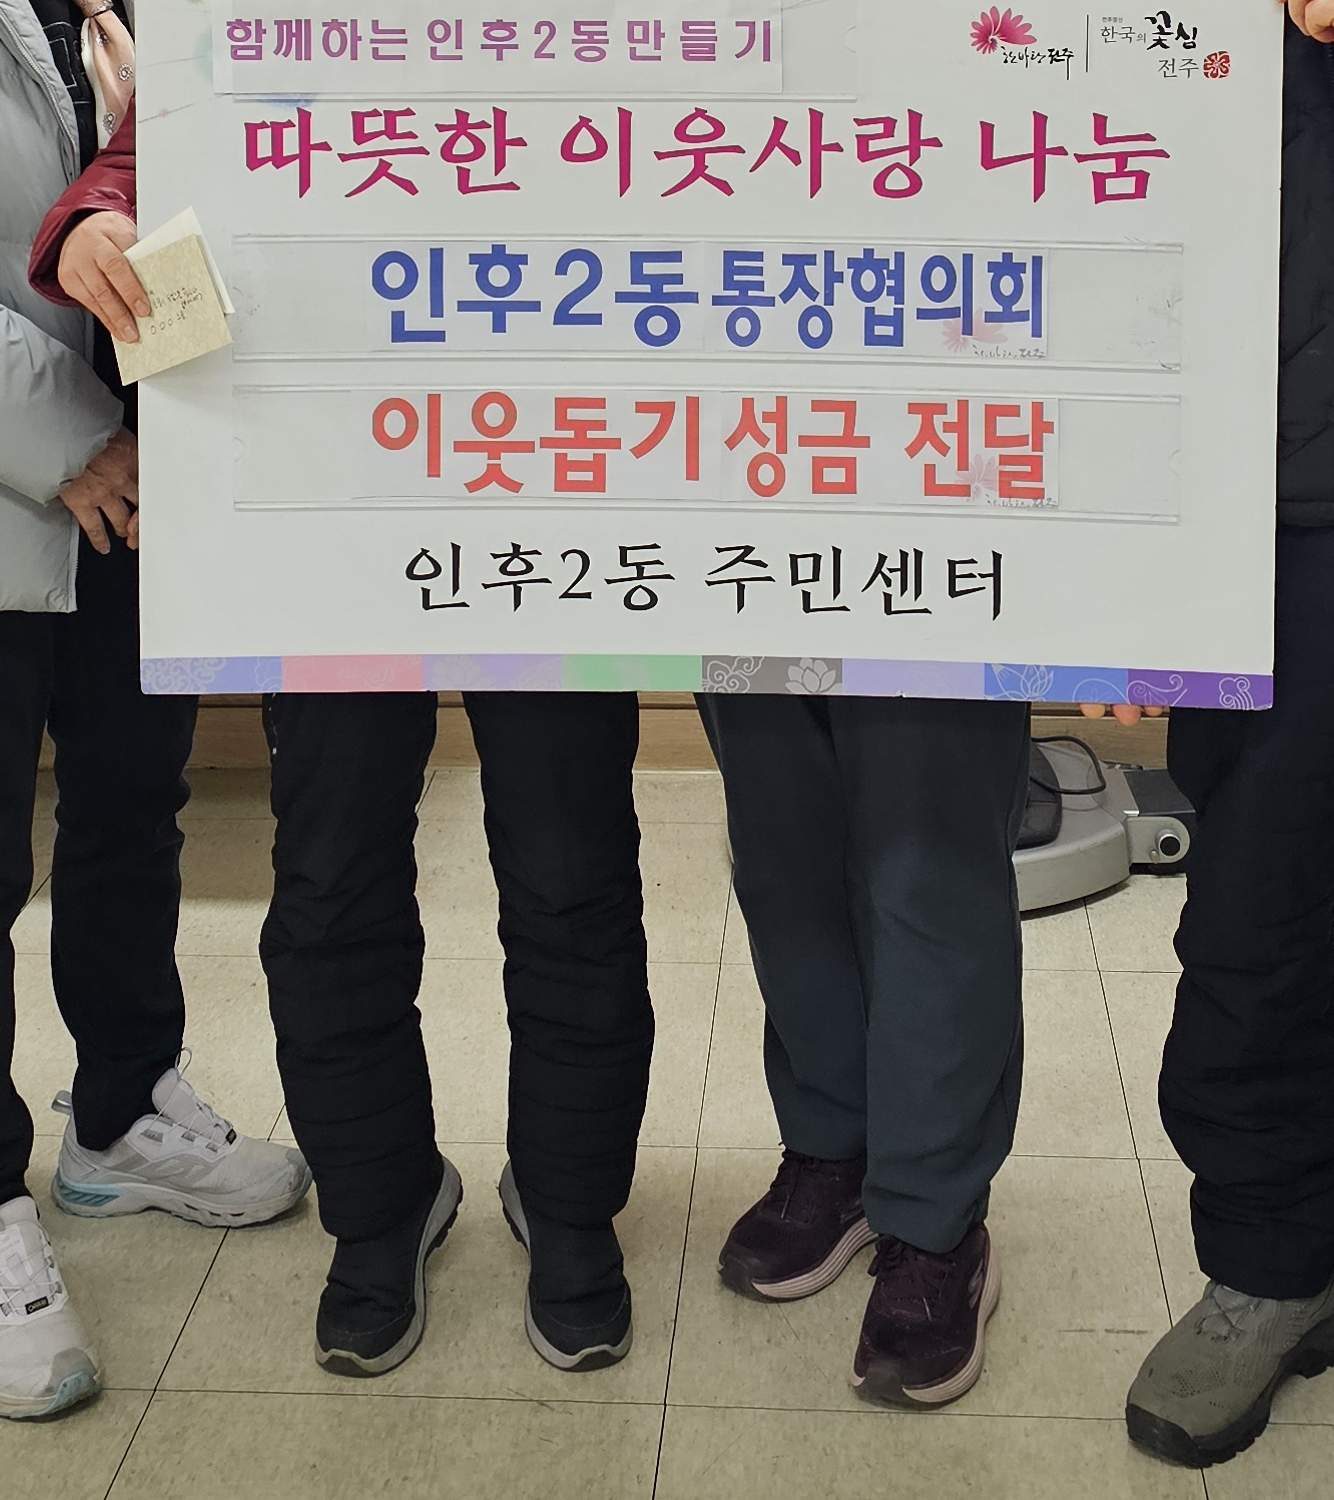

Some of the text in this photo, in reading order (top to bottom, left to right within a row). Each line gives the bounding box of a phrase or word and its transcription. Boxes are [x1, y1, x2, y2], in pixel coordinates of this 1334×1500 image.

[226, 18, 409, 62] 함께하는
[1100, 10, 1198, 51] 한국의 꽃심
[1047, 46, 1075, 81] 전주
[1157, 57, 1199, 79] 전주
[244, 106, 1171, 206] 따뜻한 이웃사랑 나눔
[371, 242, 1045, 349] 인후2동 통장협의회
[371, 390, 1055, 499] 이웃돕기 성금 전달
[404, 541, 1005, 621] 인후2동 주민센터
